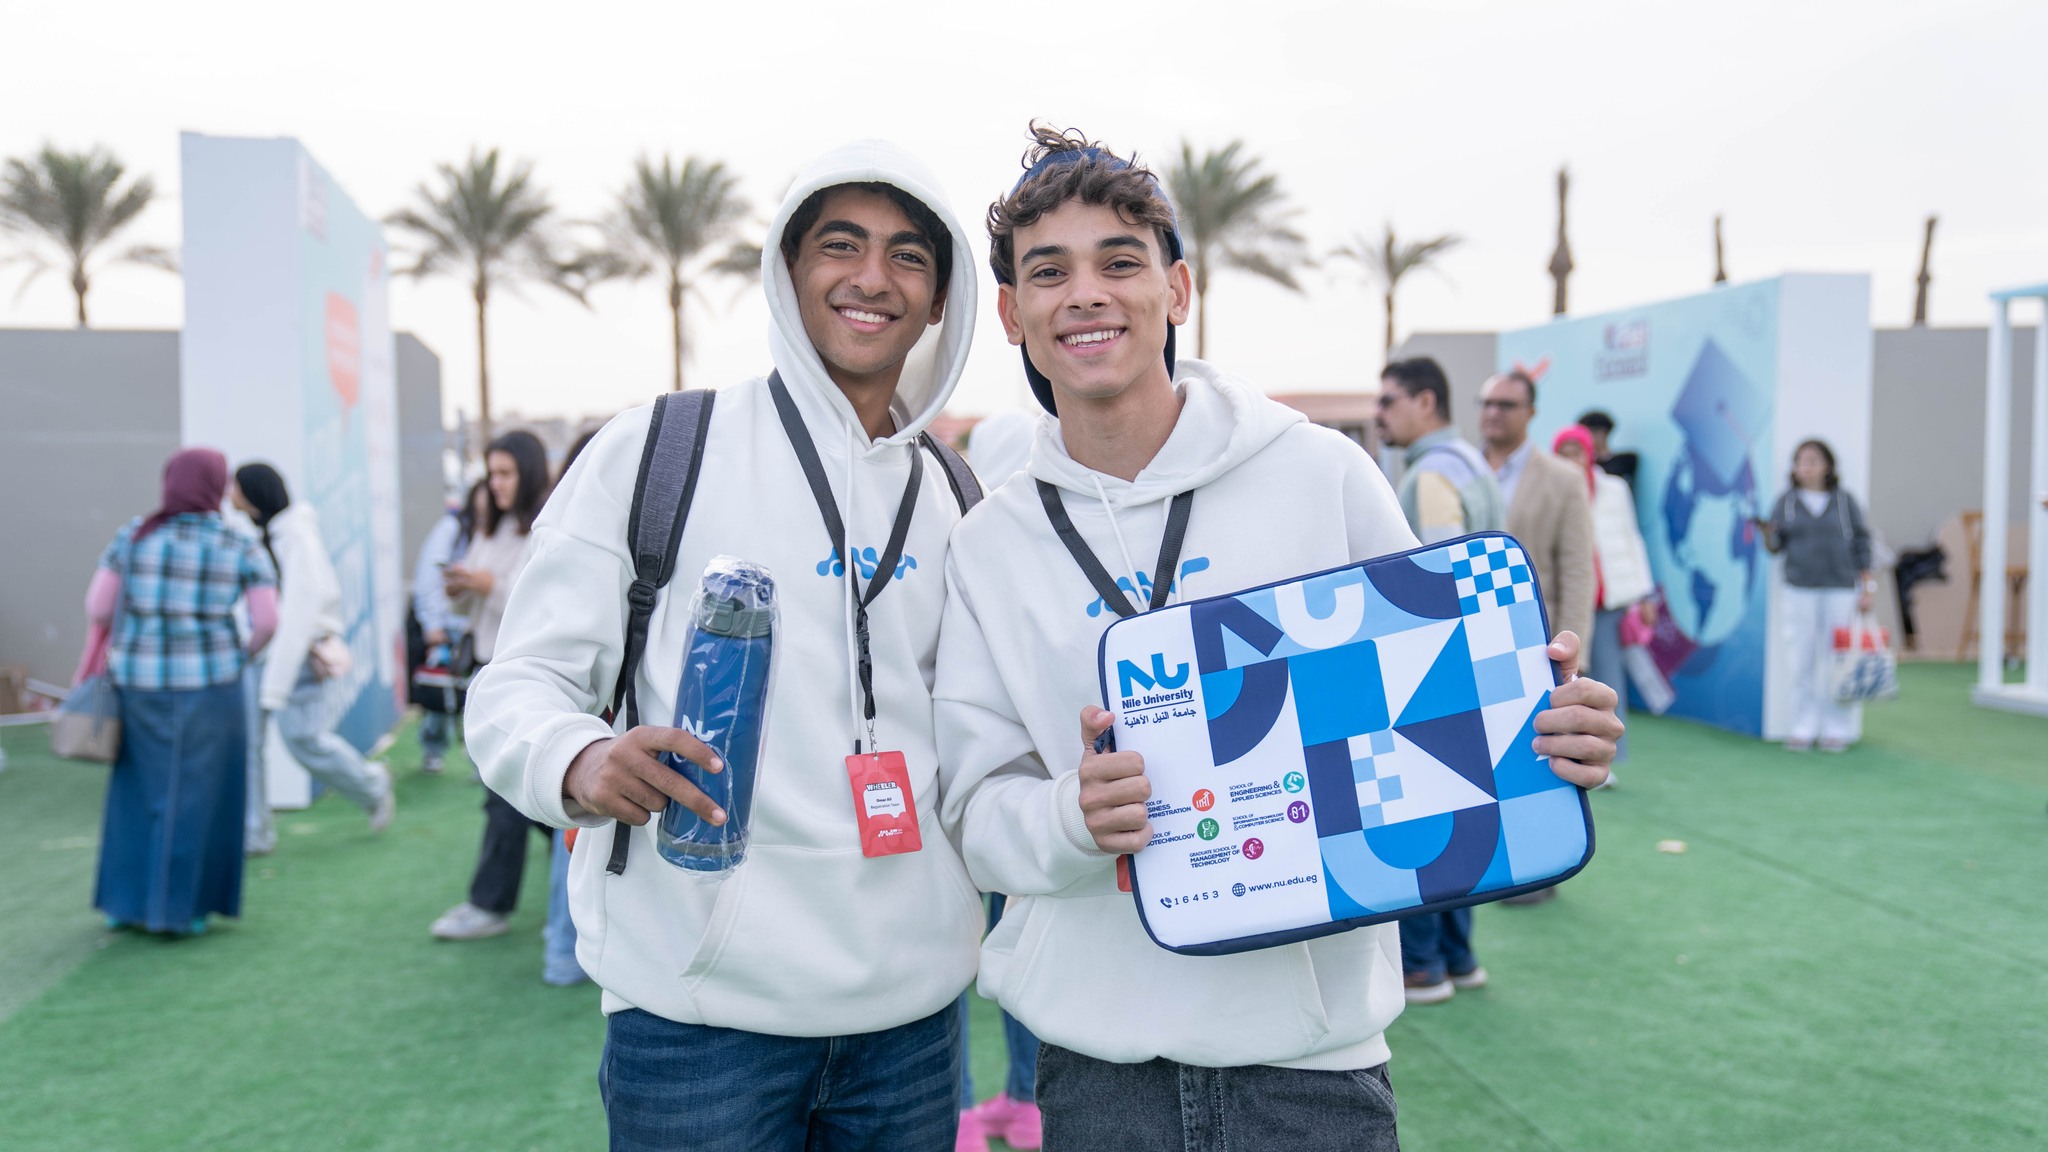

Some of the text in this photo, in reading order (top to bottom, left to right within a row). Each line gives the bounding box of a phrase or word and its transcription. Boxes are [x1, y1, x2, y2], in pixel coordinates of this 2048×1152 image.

[1117, 653, 1189, 698] NU
[1122, 689, 1193, 709] Nile University
[1125, 708, 1196, 728] جامعة النيل الأهلية
[1230, 780, 1280, 797] ENGINEERING &
[1231, 789, 1282, 803] APPLIED SCIENCES
[1148, 804, 1171, 813] SINESS
[1148, 806, 1191, 819] MINISTRATION
[1259, 812, 1284, 820] TECHNOLOGY
[1239, 820, 1264, 829] COMPUTER
[1146, 833, 1195, 847] OTECHNOLOGY
[1189, 849, 1212, 857] GRADUATE
[1190, 851, 1231, 863] MANAGEMENT
[1191, 857, 1230, 868] TECHNOLOGY
[1249, 874, 1318, 892] www.nu.edu.eg
